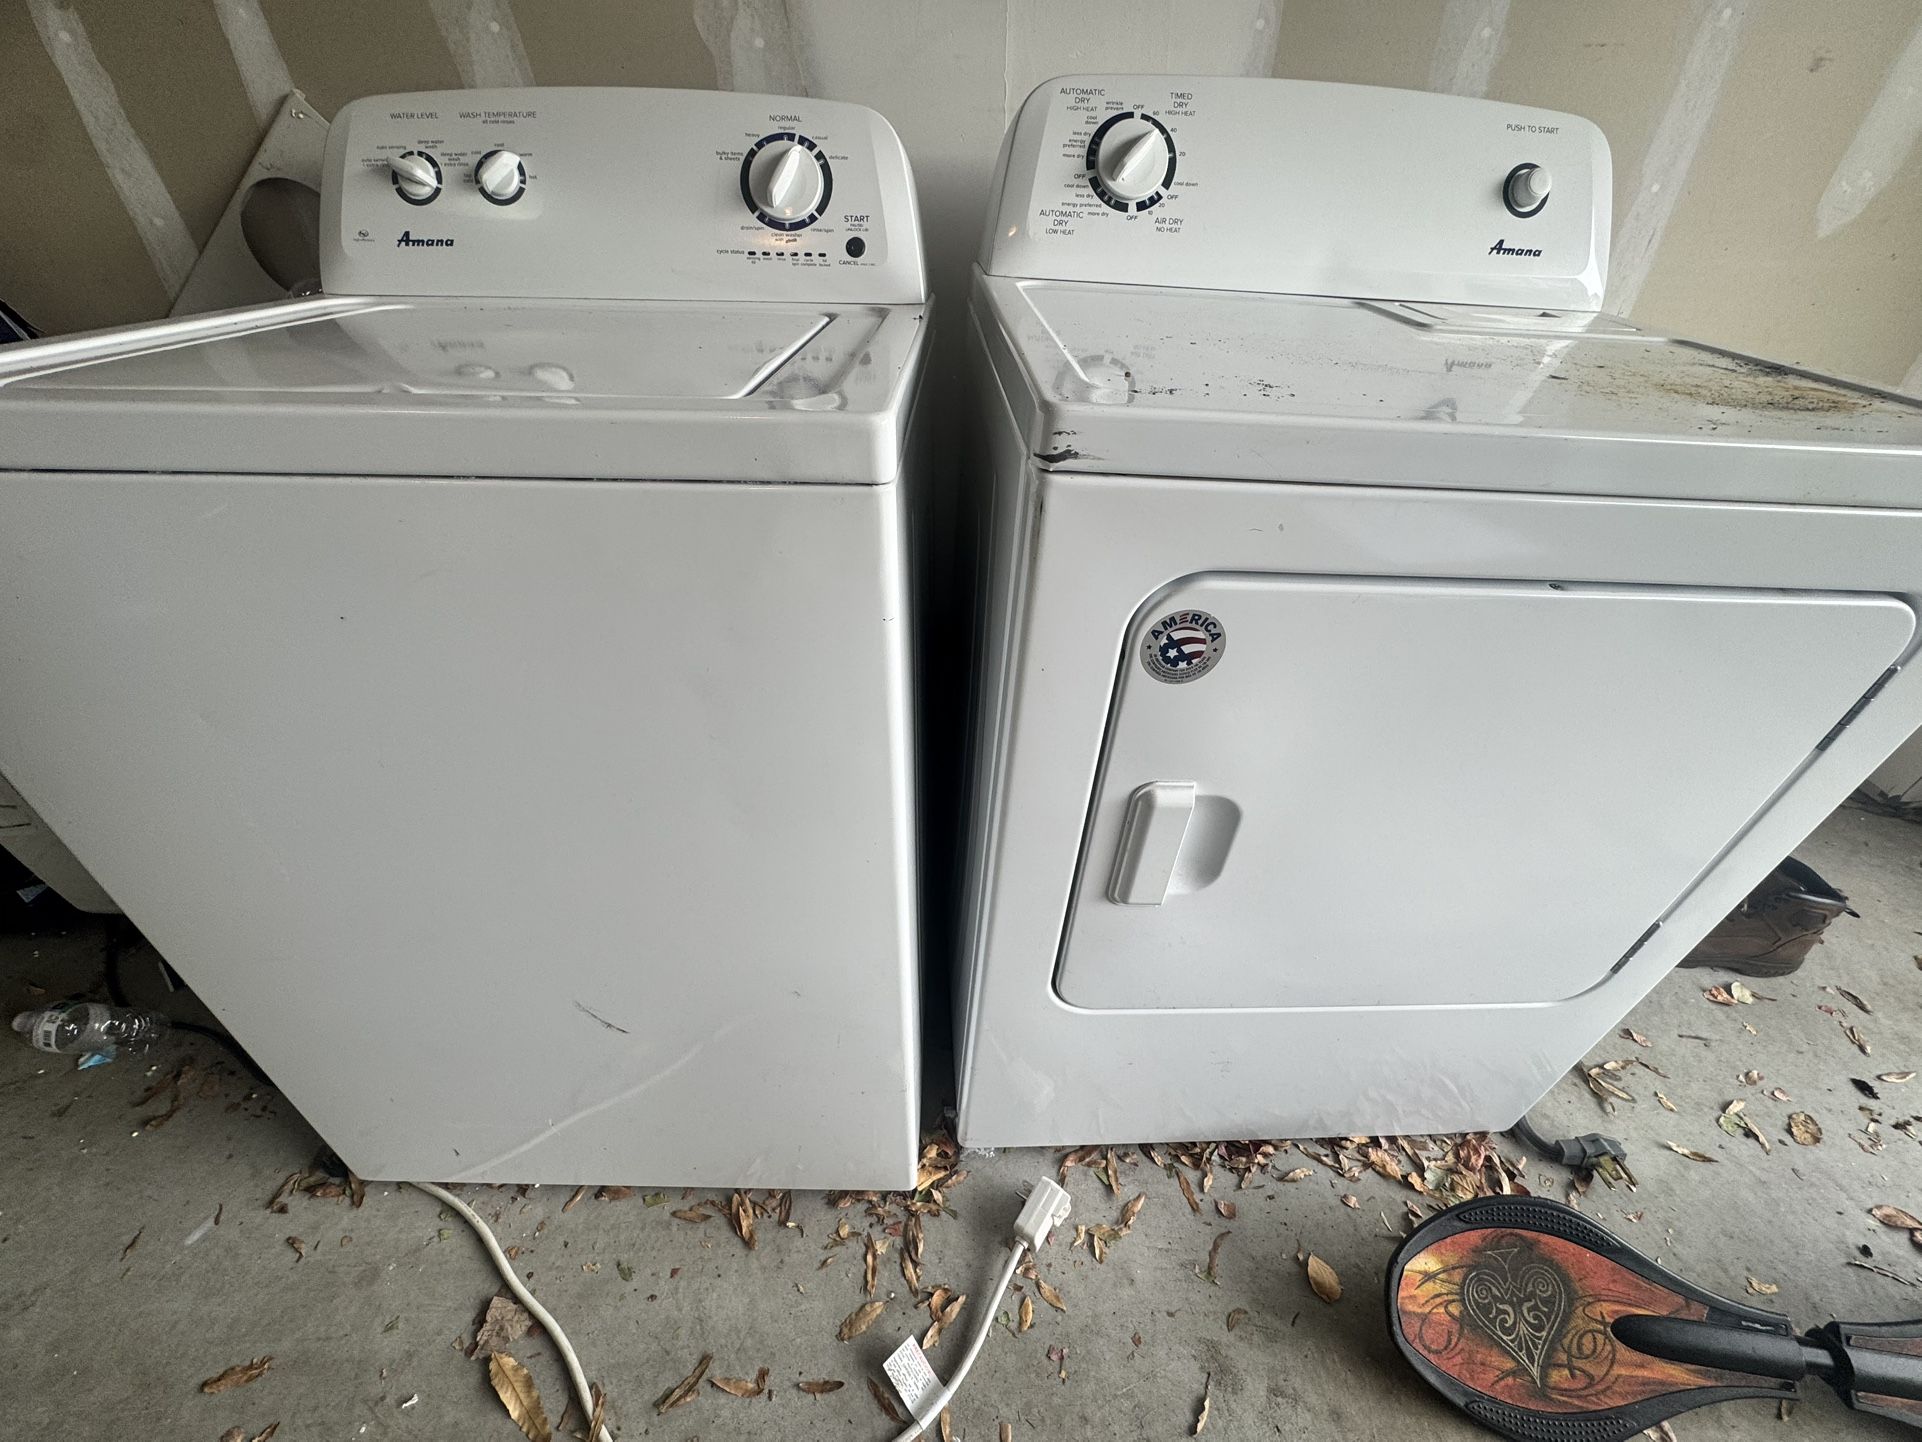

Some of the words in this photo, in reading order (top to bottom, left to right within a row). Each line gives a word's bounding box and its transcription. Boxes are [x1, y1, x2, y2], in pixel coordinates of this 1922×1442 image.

[1060, 88, 1105, 96] AUTOMATIC
[1170, 92, 1192, 100] TIMED
[459, 111, 481, 119] WASH
[484, 111, 537, 119] TEMPERATURE
[1506, 124, 1525, 132] PUSH
[1528, 125, 1536, 133] TO
[1538, 126, 1559, 134] START
[1039, 209, 1084, 219] AUTOMATIC
[844, 215, 870, 223] START
[1053, 219, 1069, 227] DRY
[397, 230, 455, 248] Amana
[1488, 239, 1542, 257] Amana
[1151, 612, 1222, 643] AMERICA
